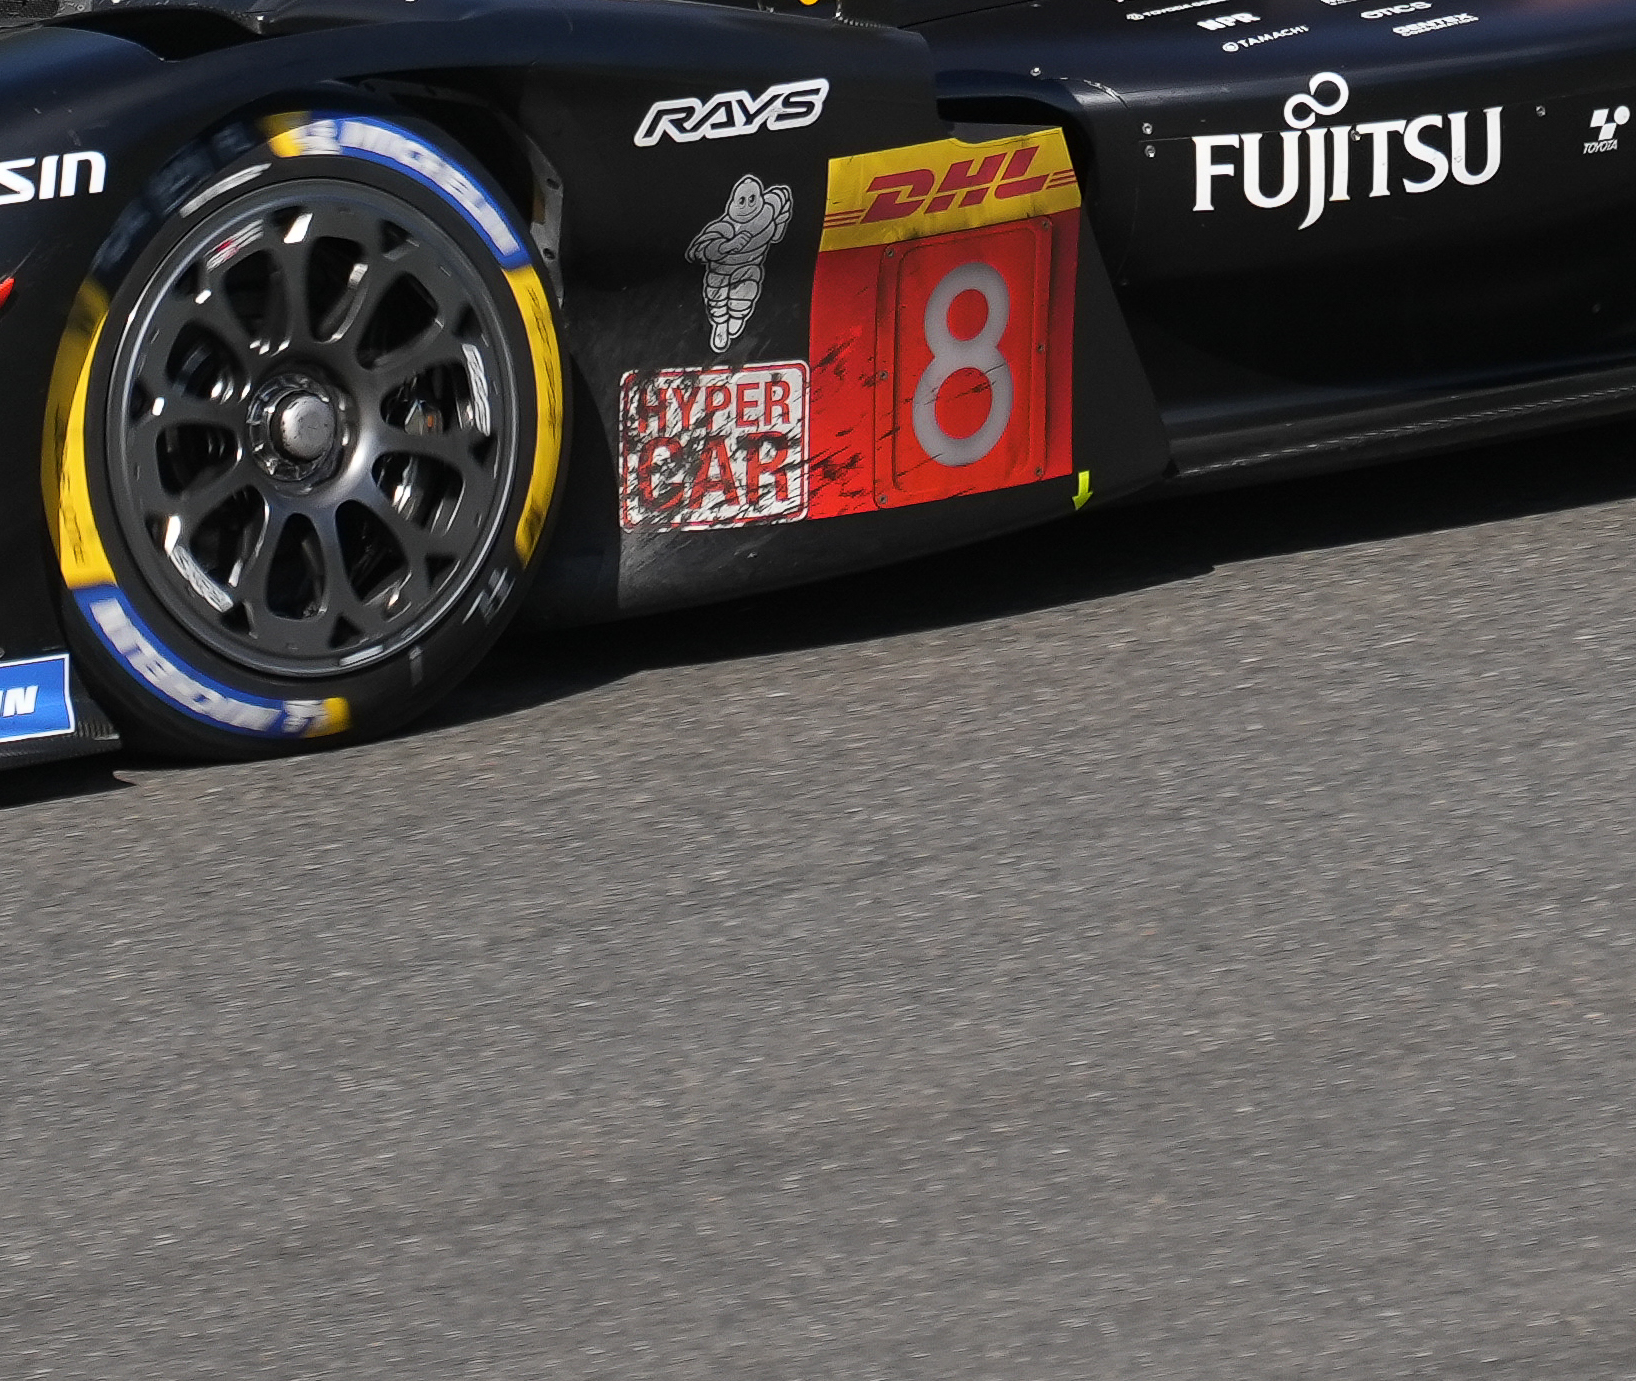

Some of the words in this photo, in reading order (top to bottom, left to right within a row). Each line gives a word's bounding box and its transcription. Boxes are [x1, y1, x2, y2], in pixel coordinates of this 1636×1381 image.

[1196, 12, 1262, 31] NPR
[1236, 24, 1310, 49] TAMACHI
[634, 79, 829, 147] RAYS
[1582, 139, 1618, 155] TOYOTA
[860, 146, 1050, 223] DHL
[1192, 106, 1503, 231] FUJITSU
[912, 261, 1014, 467] 8
[639, 378, 792, 433] HYPER
[635, 430, 791, 511] CAR
